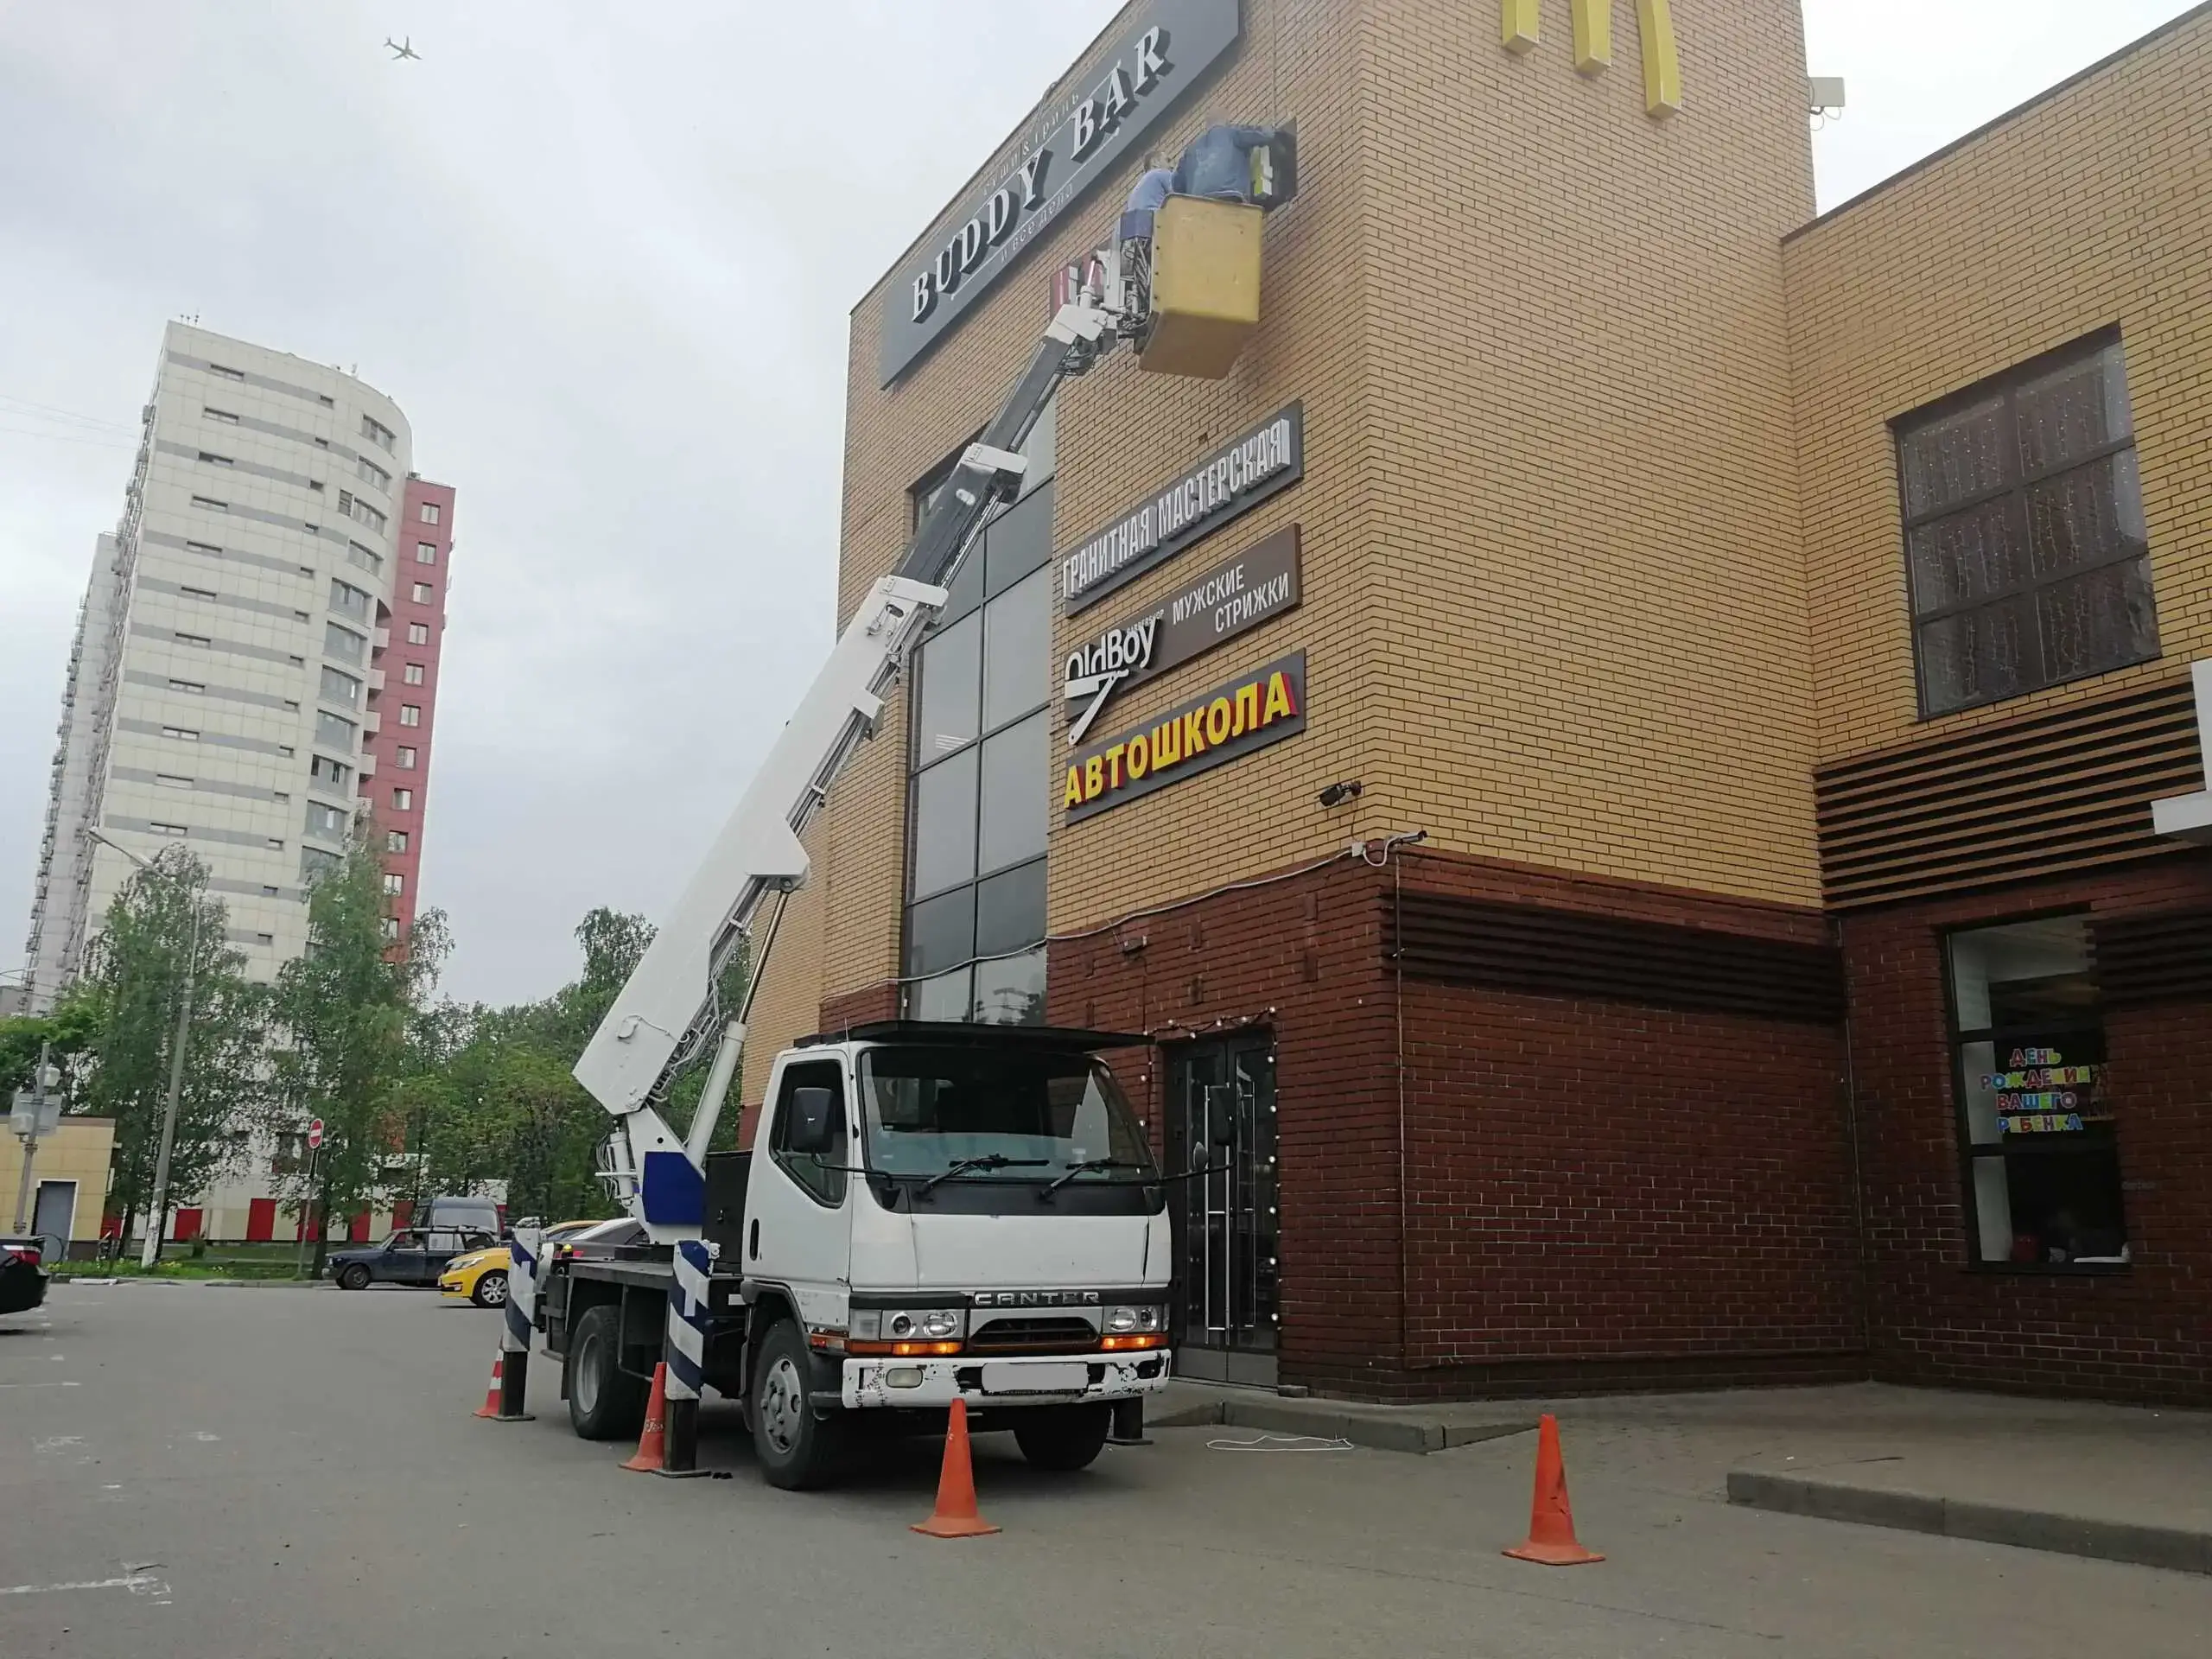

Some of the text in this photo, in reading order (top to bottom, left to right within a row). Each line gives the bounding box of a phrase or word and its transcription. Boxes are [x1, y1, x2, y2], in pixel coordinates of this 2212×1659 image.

[912, 25, 1165, 321] BUDDY BAR
[1064, 418, 1290, 598] ГРАНИТНАЯ МАСТЕРСКАЯ
[1173, 563, 1244, 626] МУЖСКИЕ
[1215, 571, 1289, 633] СТРИЖКИ
[1065, 670, 1294, 809] АВТОШКОЛА
[2009, 1047, 2062, 1068] ДЕНЬ
[1996, 1091, 2078, 1111] ВАШЕГО
[974, 1291, 1100, 1306] CANTER
